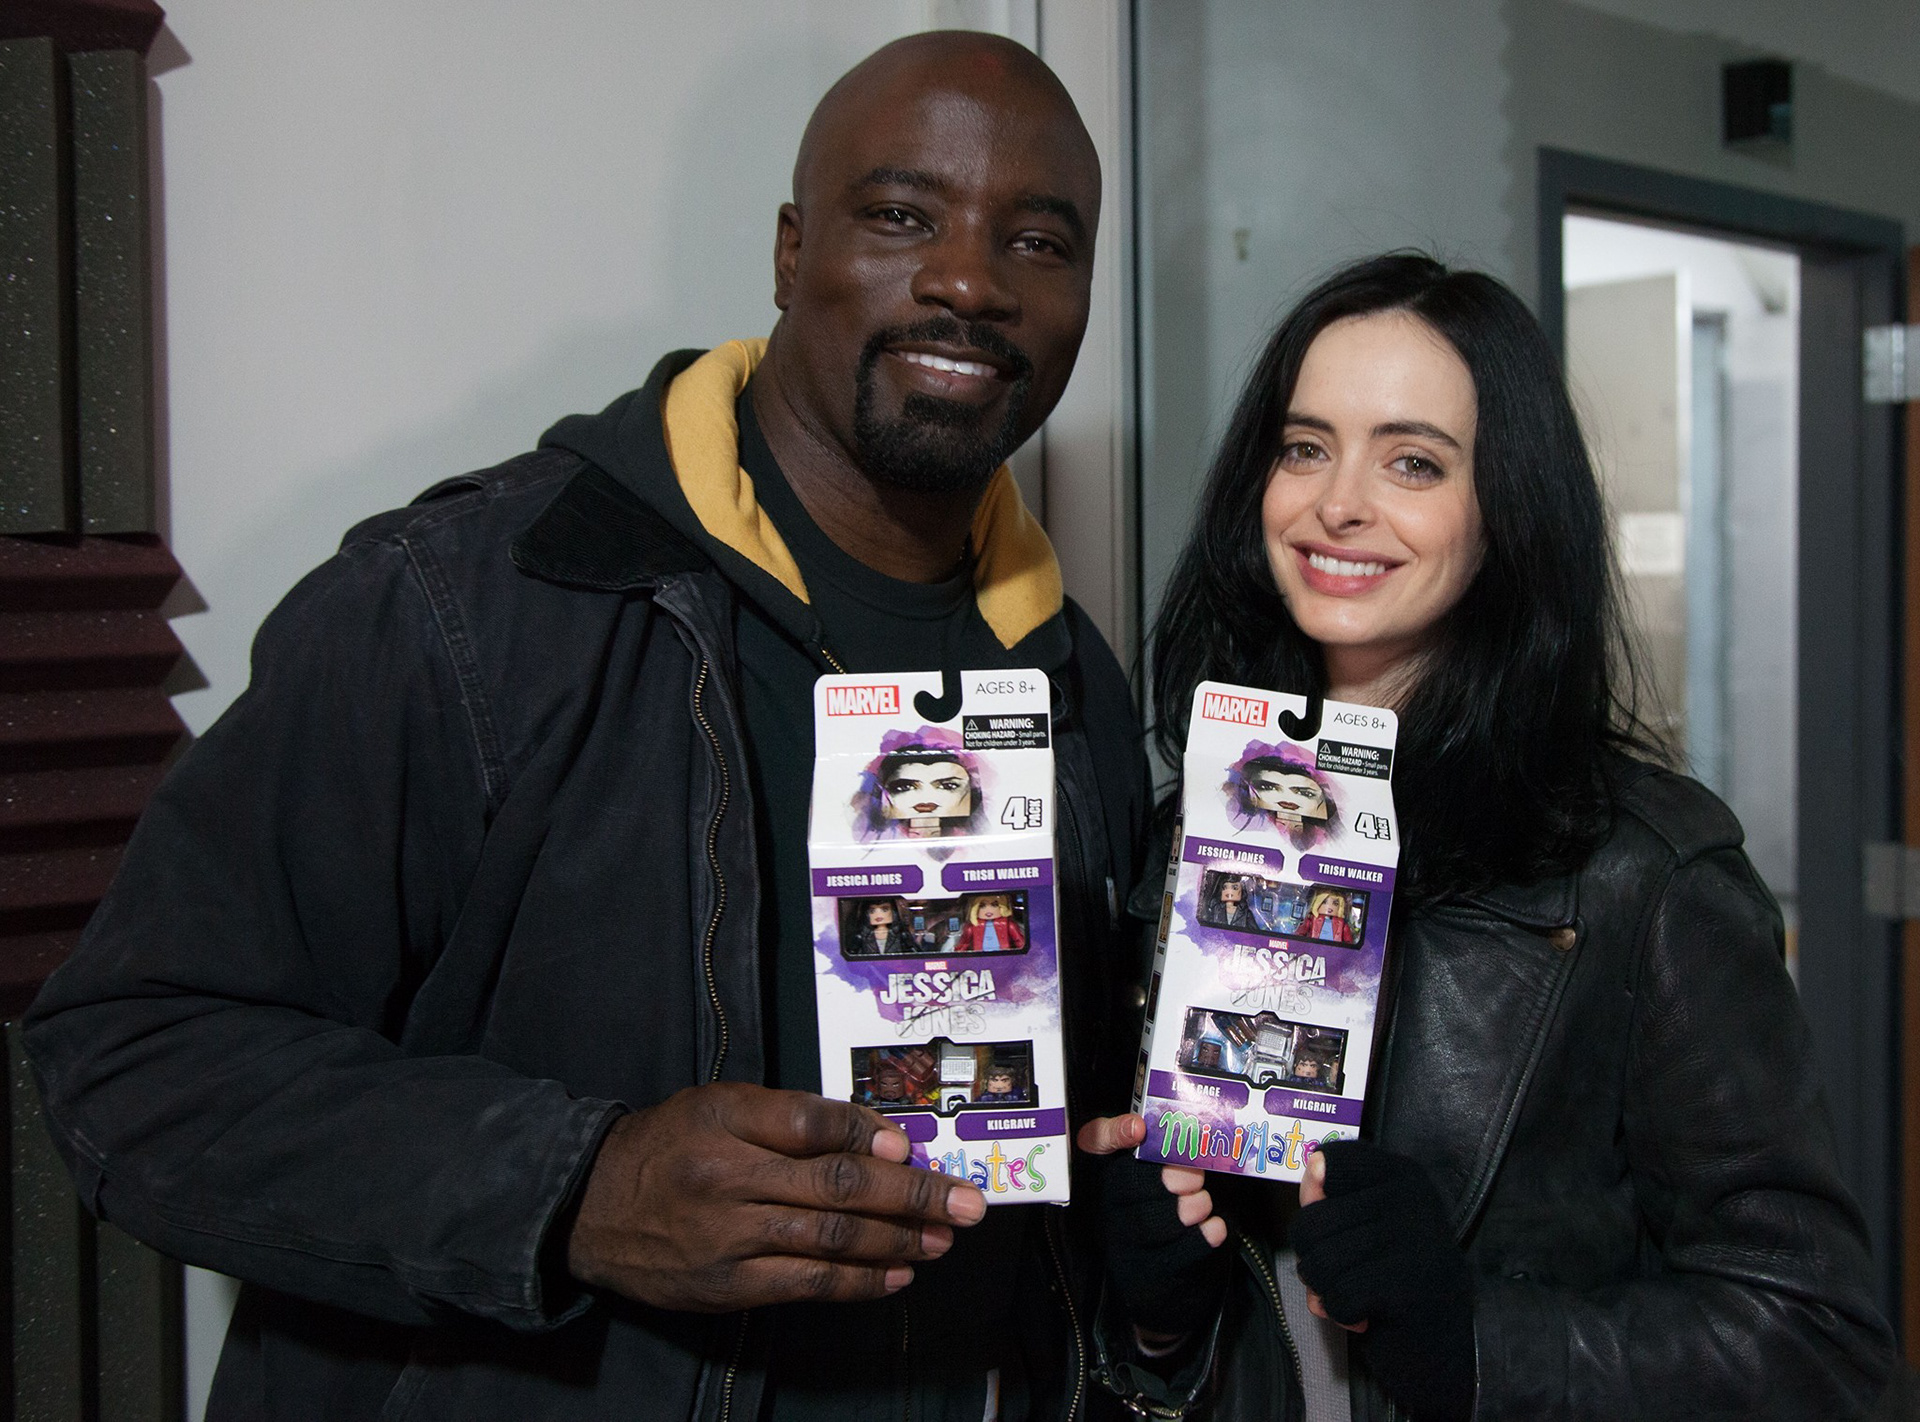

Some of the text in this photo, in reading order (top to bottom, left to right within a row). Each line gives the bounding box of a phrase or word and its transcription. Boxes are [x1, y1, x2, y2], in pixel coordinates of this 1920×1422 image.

[976, 681, 1036, 694] AGES 8+
[828, 686, 899, 715] MARVEL
[1203, 692, 1268, 727] MARVEL
[989, 718, 1034, 730] WARNING:
[1334, 712, 1386, 730] AGES 8+
[965, 731, 991, 740] CHOKING
[992, 730, 1016, 738] HAZARD
[984, 739, 1002, 747] children
[1318, 754, 1342, 764] CHOKING
[1342, 756, 1362, 766] HAZARD
[1342, 746, 1380, 760] WARNING:
[1001, 796, 1042, 830] 4 PACK
[1354, 812, 1391, 840] 4 PACK
[1197, 845, 1265, 865] JESSICA JONES
[826, 873, 902, 888] JESSICA JONES
[963, 867, 1039, 881] TRISH WALKER
[1318, 863, 1384, 883] TRISH WALKER
[1227, 944, 1326, 986] JESSICA
[880, 970, 996, 1004] JESSICA
[896, 1004, 986, 1038] JONES
[1196, 1084, 1220, 1098] CAGE
[1292, 1098, 1337, 1114] KILGRAVE
[987, 1118, 1036, 1131] KILGRAVE
